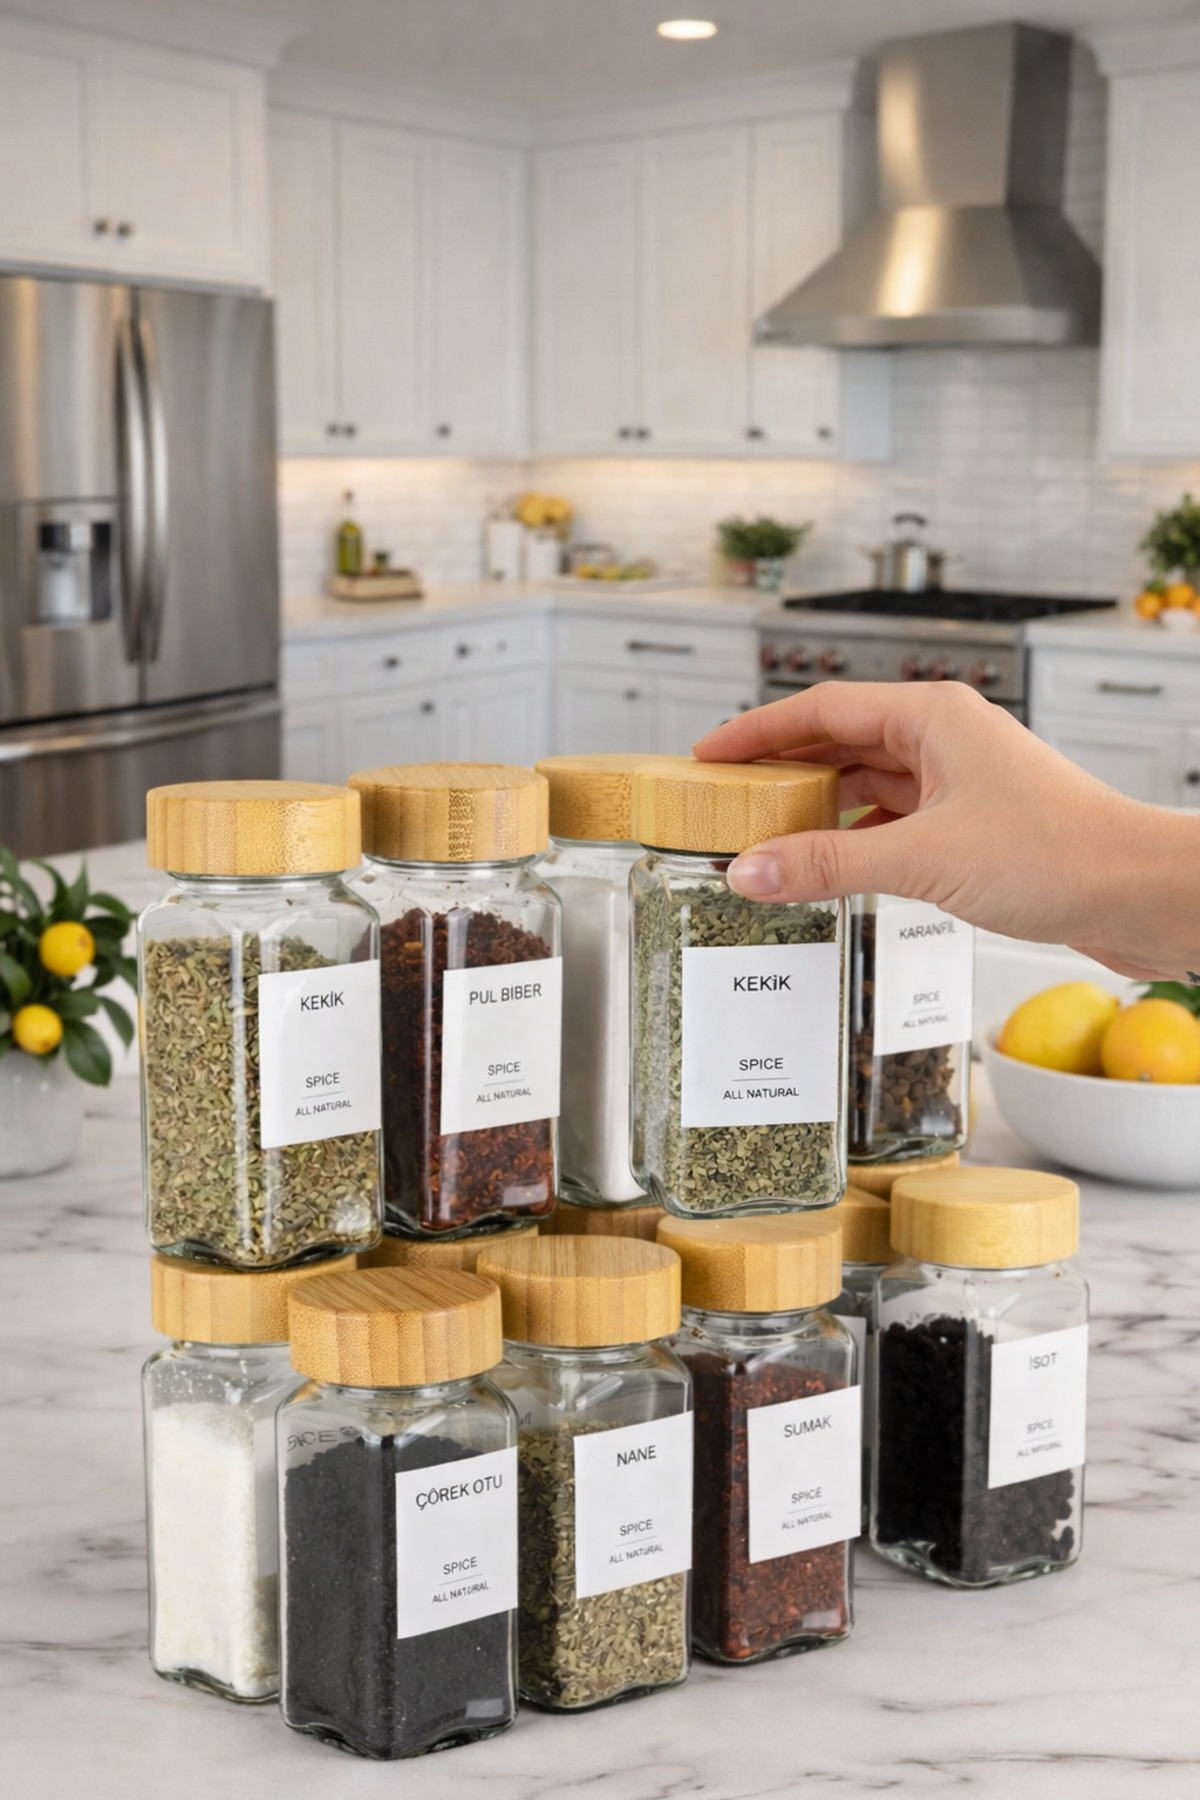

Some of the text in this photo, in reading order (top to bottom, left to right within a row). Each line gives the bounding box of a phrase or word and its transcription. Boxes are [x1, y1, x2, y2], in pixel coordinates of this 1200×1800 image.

[469, 982, 542, 1006] PUL BIBER
[912, 990, 941, 1005] SPICE
[902, 1020, 917, 1029] ALL
[487, 1061, 521, 1077] SPICE
[738, 1057, 784, 1072] SPICE
[305, 1072, 341, 1089] SPICE
[476, 1087, 533, 1104] ALL NATURAL
[722, 1087, 800, 1101] ALL NATURAL
[295, 1105, 312, 1118] ALL
[783, 1415, 833, 1439] SUMAK
[1026, 1418, 1054, 1435] SPICE
[616, 1444, 658, 1467] NANE
[1016, 1449, 1030, 1458] ALL
[472, 1473, 503, 1495] OTU
[791, 1486, 823, 1504] SPICE
[619, 1518, 653, 1538] SPICE
[781, 1520, 796, 1531] ALL
[442, 1555, 478, 1576] SPICE
[608, 1553, 624, 1565] ALL
[431, 1592, 449, 1604] ALL
